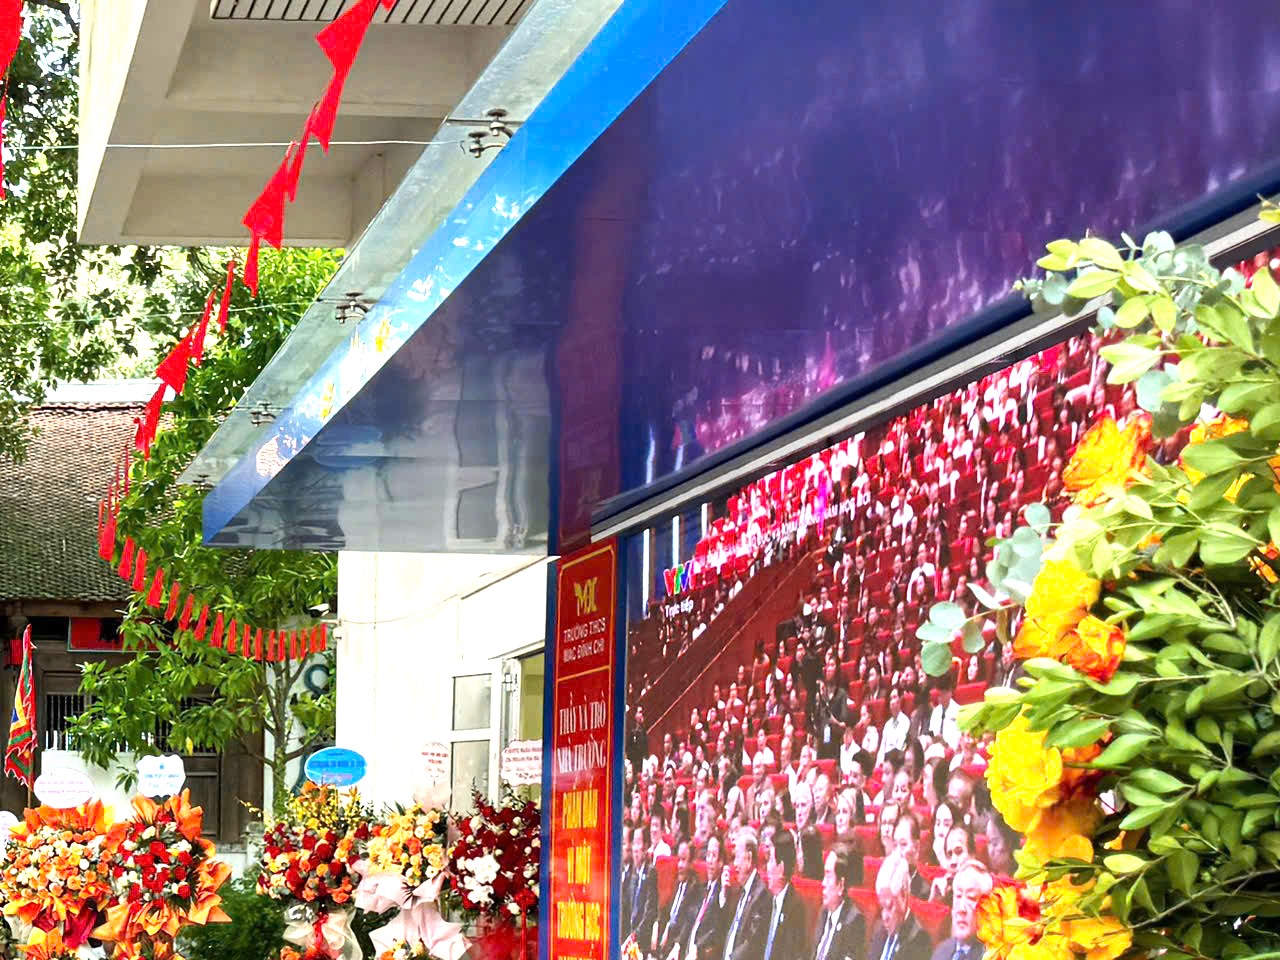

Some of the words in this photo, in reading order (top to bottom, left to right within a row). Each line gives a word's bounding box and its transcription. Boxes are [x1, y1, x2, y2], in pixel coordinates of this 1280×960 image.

[579, 694, 588, 731] VÀ
[590, 690, 606, 730] TRÒ
[573, 733, 606, 772] TRƯỜNG
[557, 891, 584, 940] TRƯỜNG
